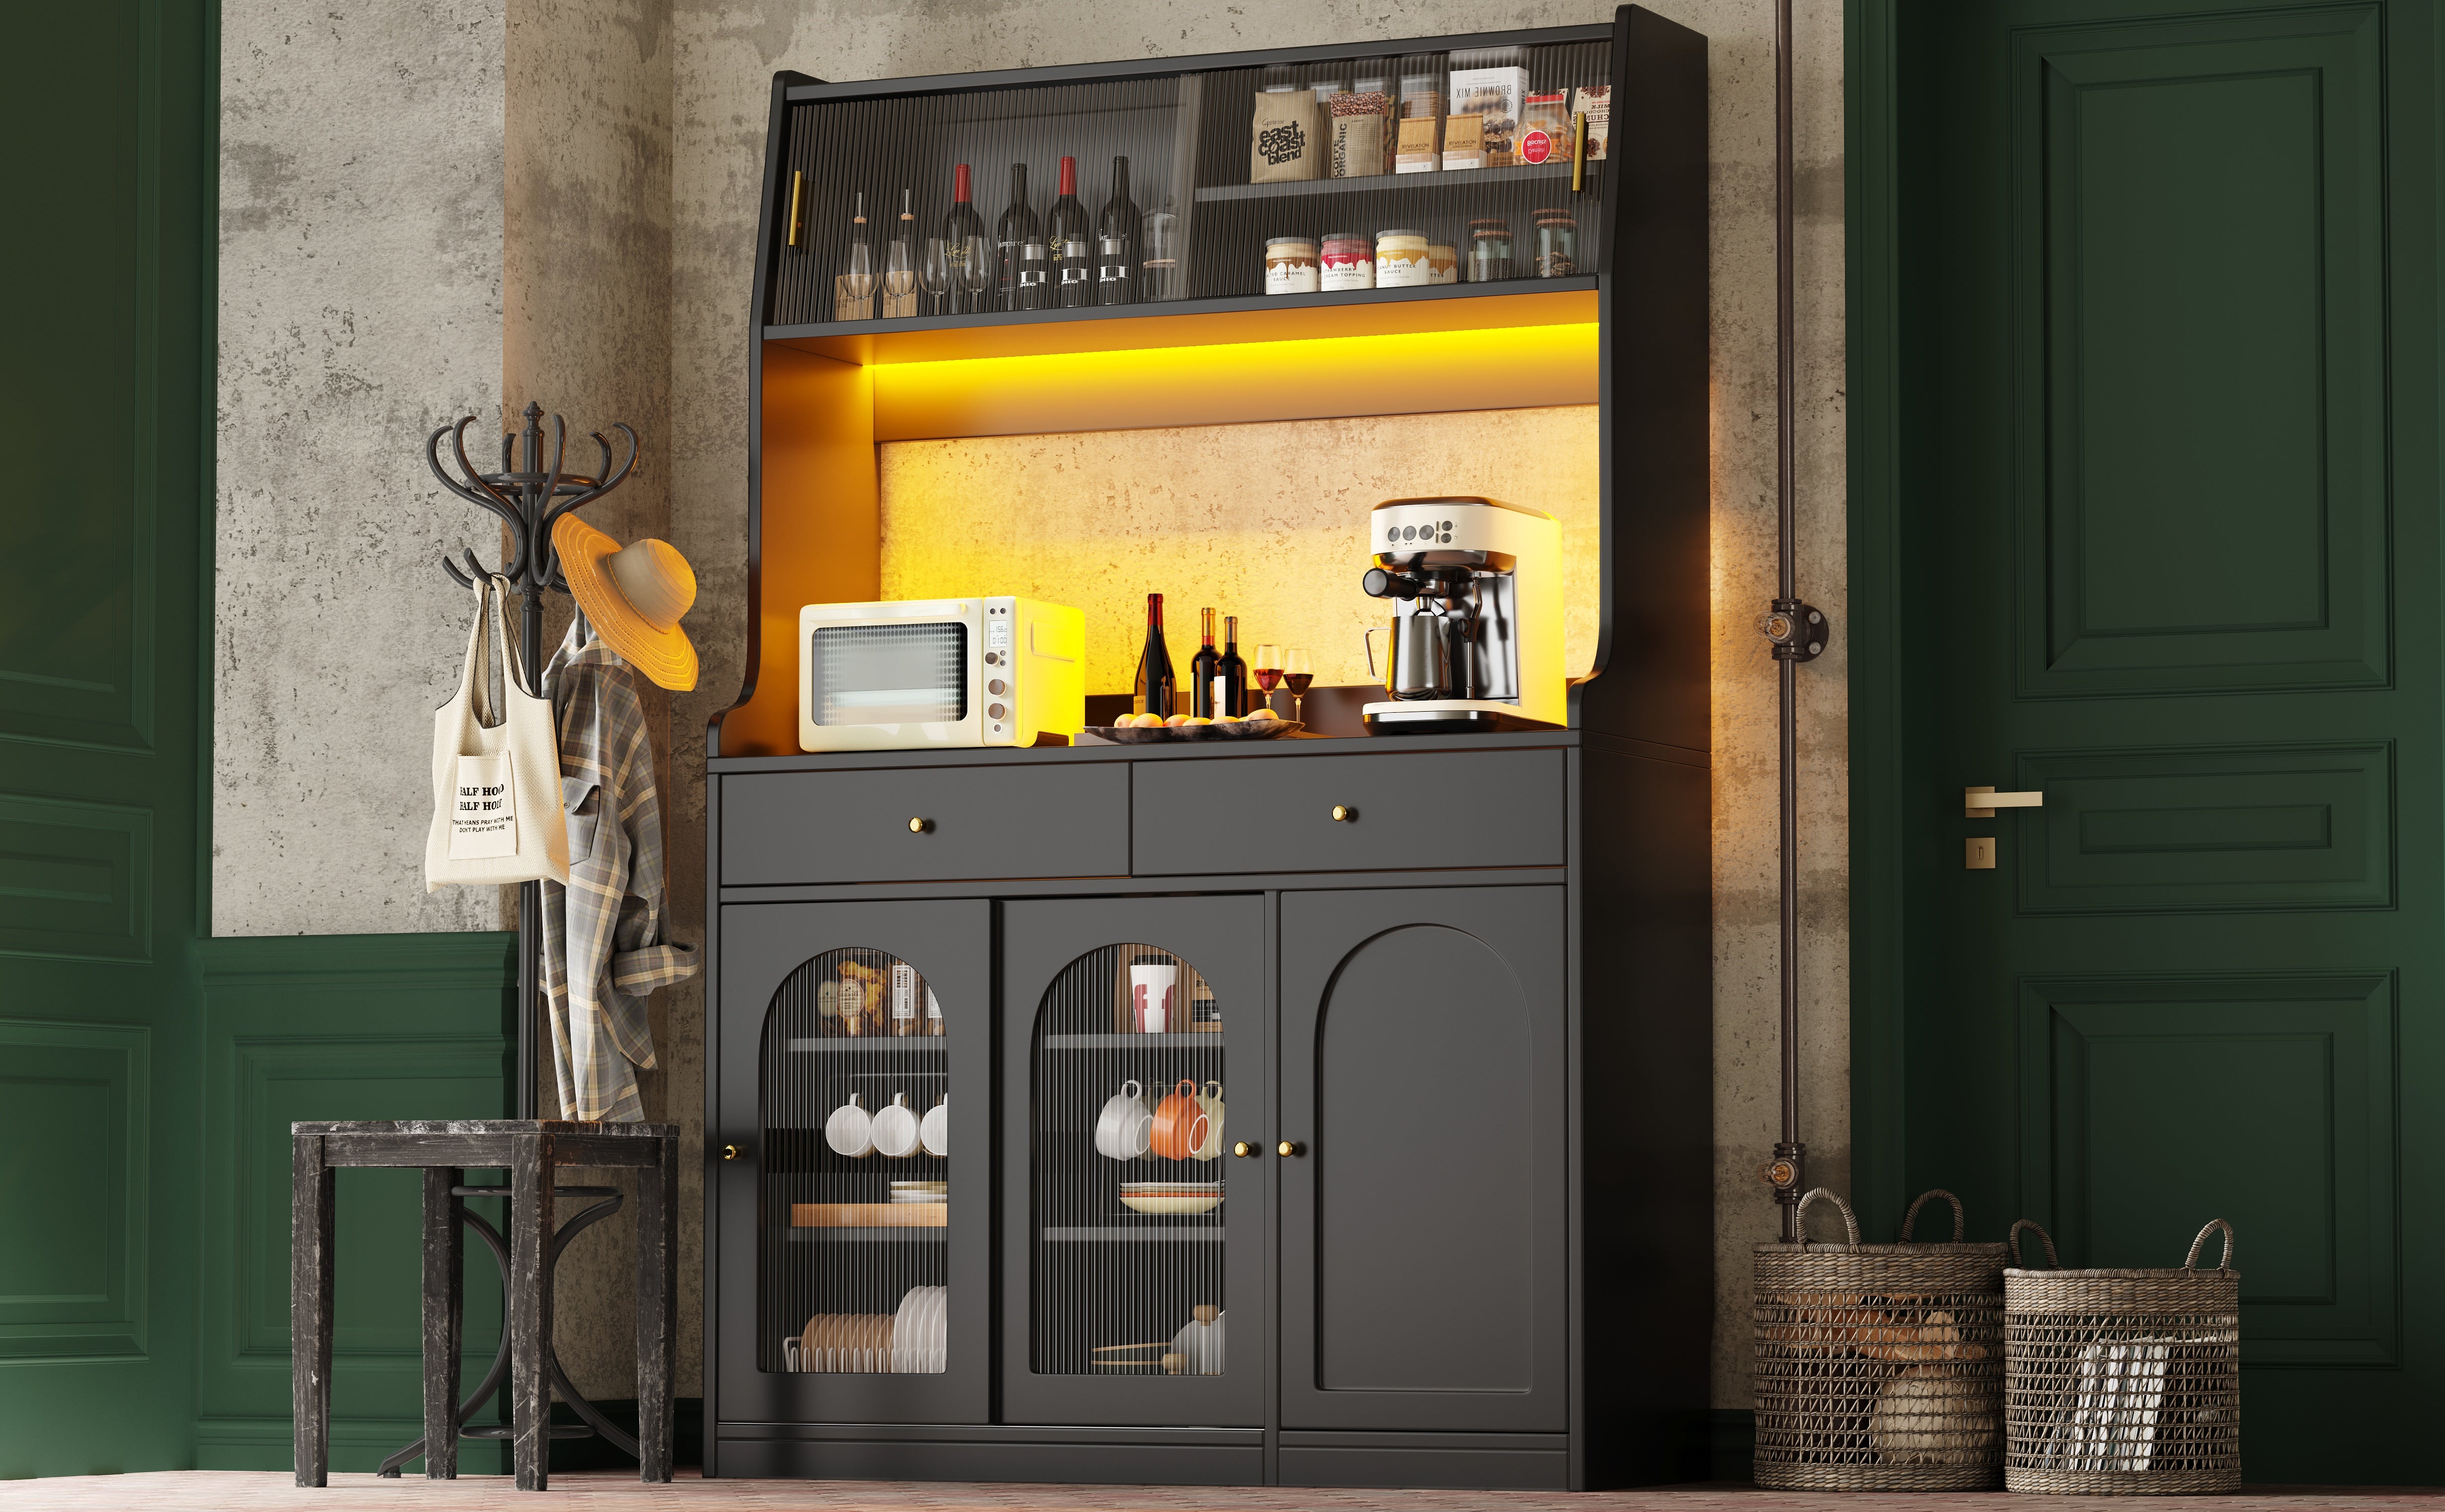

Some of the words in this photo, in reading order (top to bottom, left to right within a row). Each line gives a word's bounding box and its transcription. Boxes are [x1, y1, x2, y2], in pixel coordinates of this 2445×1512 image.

[1259, 120, 1299, 144] east
[1258, 131, 1306, 156] coast
[1338, 123, 1347, 177] ORGANIC
[1267, 146, 1302, 166] blend
[460, 786, 479, 796] HALF
[460, 801, 479, 810] HALF
